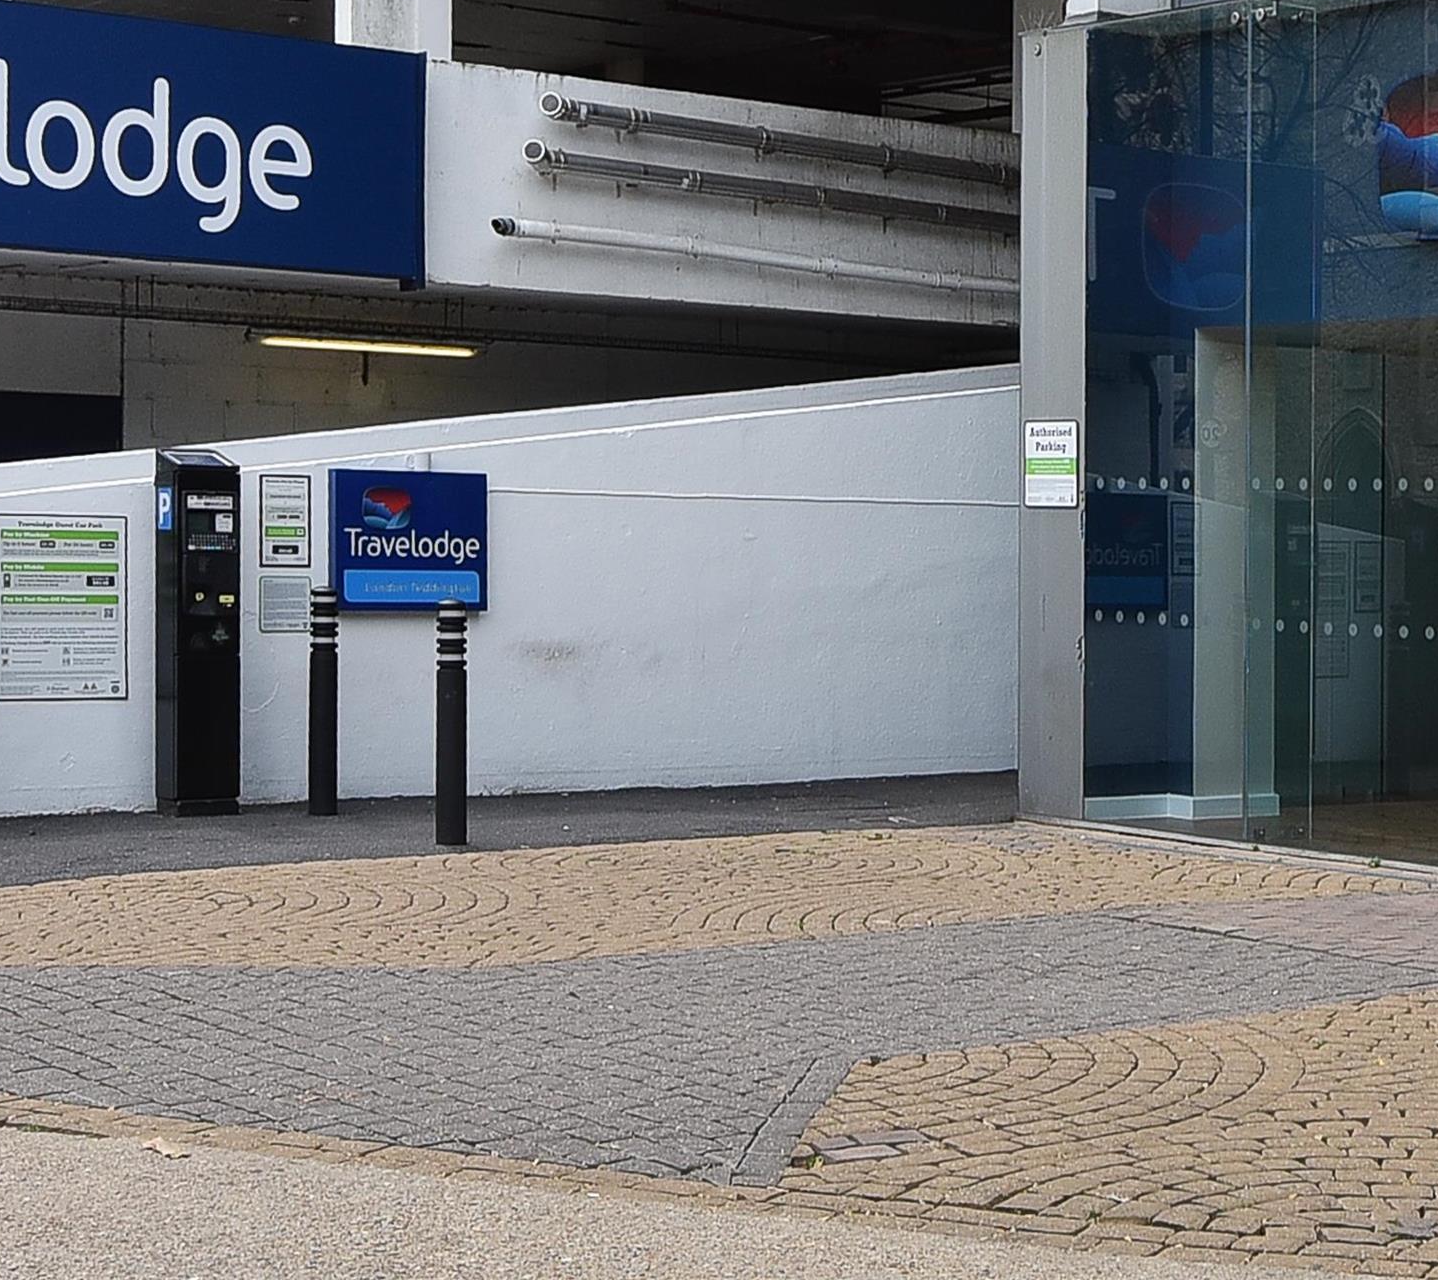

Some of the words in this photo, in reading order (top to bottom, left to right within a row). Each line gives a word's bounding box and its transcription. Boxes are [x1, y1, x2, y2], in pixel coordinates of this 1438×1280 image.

[1029, 426, 1073, 437] Authorised
[1035, 441, 1066, 454] Parking
[159, 492, 171, 526] P
[344, 527, 480, 565] Travelodge
